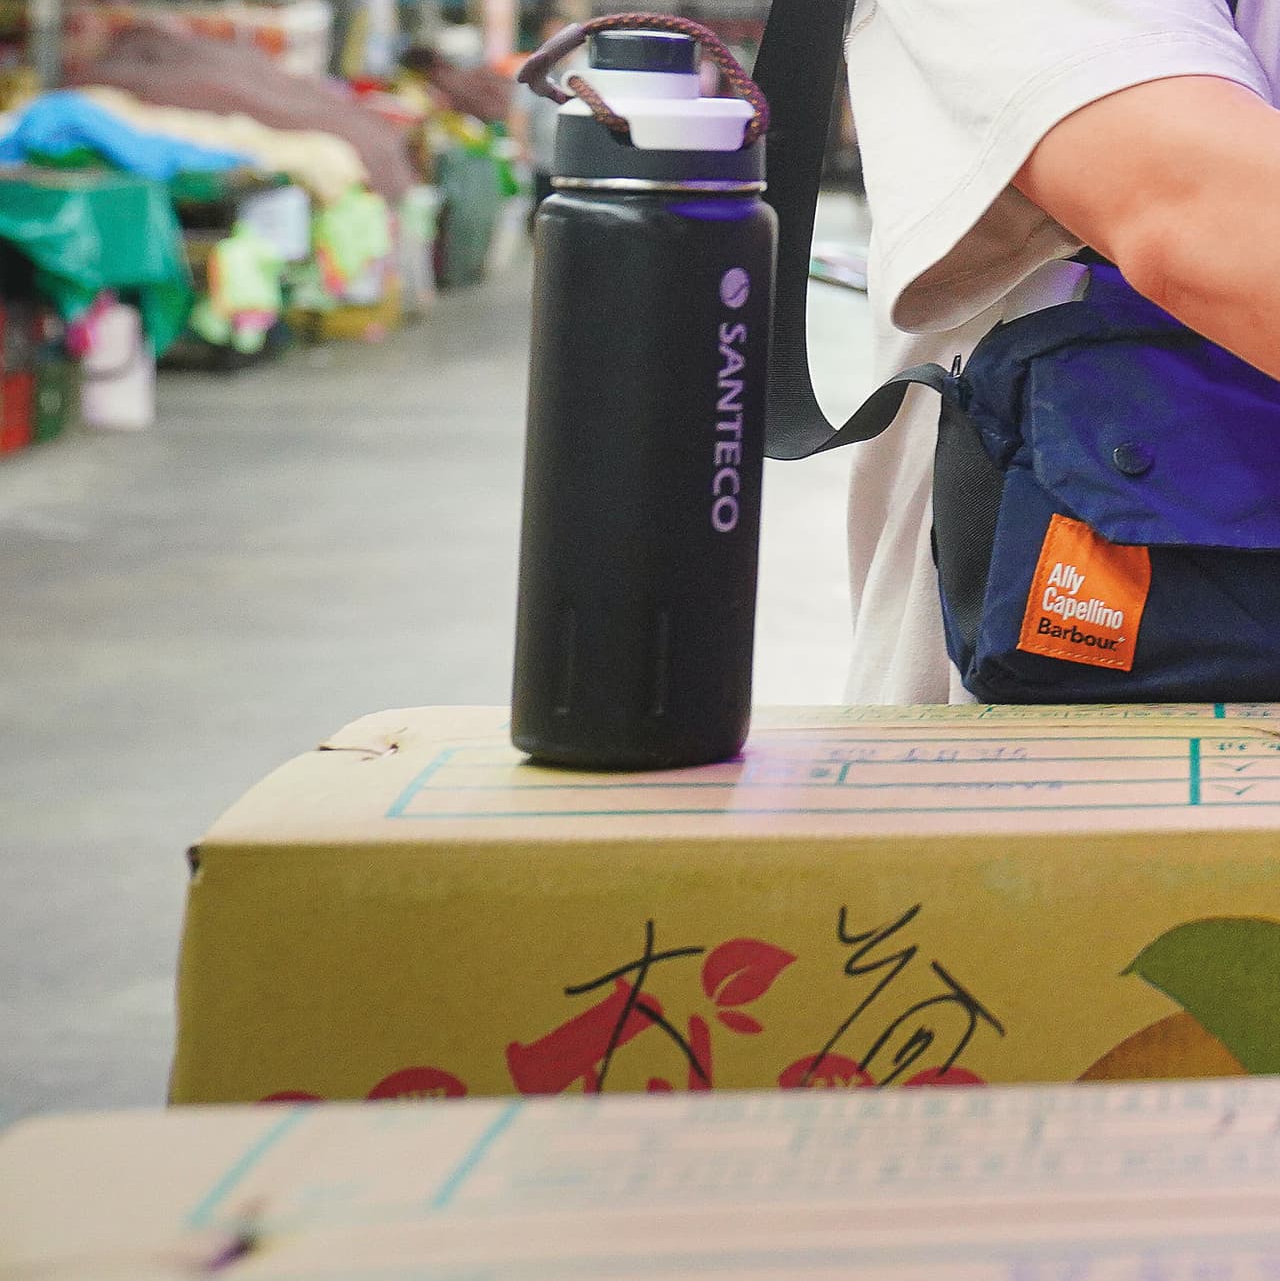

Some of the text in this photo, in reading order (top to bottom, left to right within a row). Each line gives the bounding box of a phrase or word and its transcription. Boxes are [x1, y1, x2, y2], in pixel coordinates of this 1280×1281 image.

[710, 322, 748, 533] SANTECO
[1047, 562, 1085, 594] Ally
[1042, 586, 1124, 630] Capellino
[1037, 617, 1117, 651] Barbour
